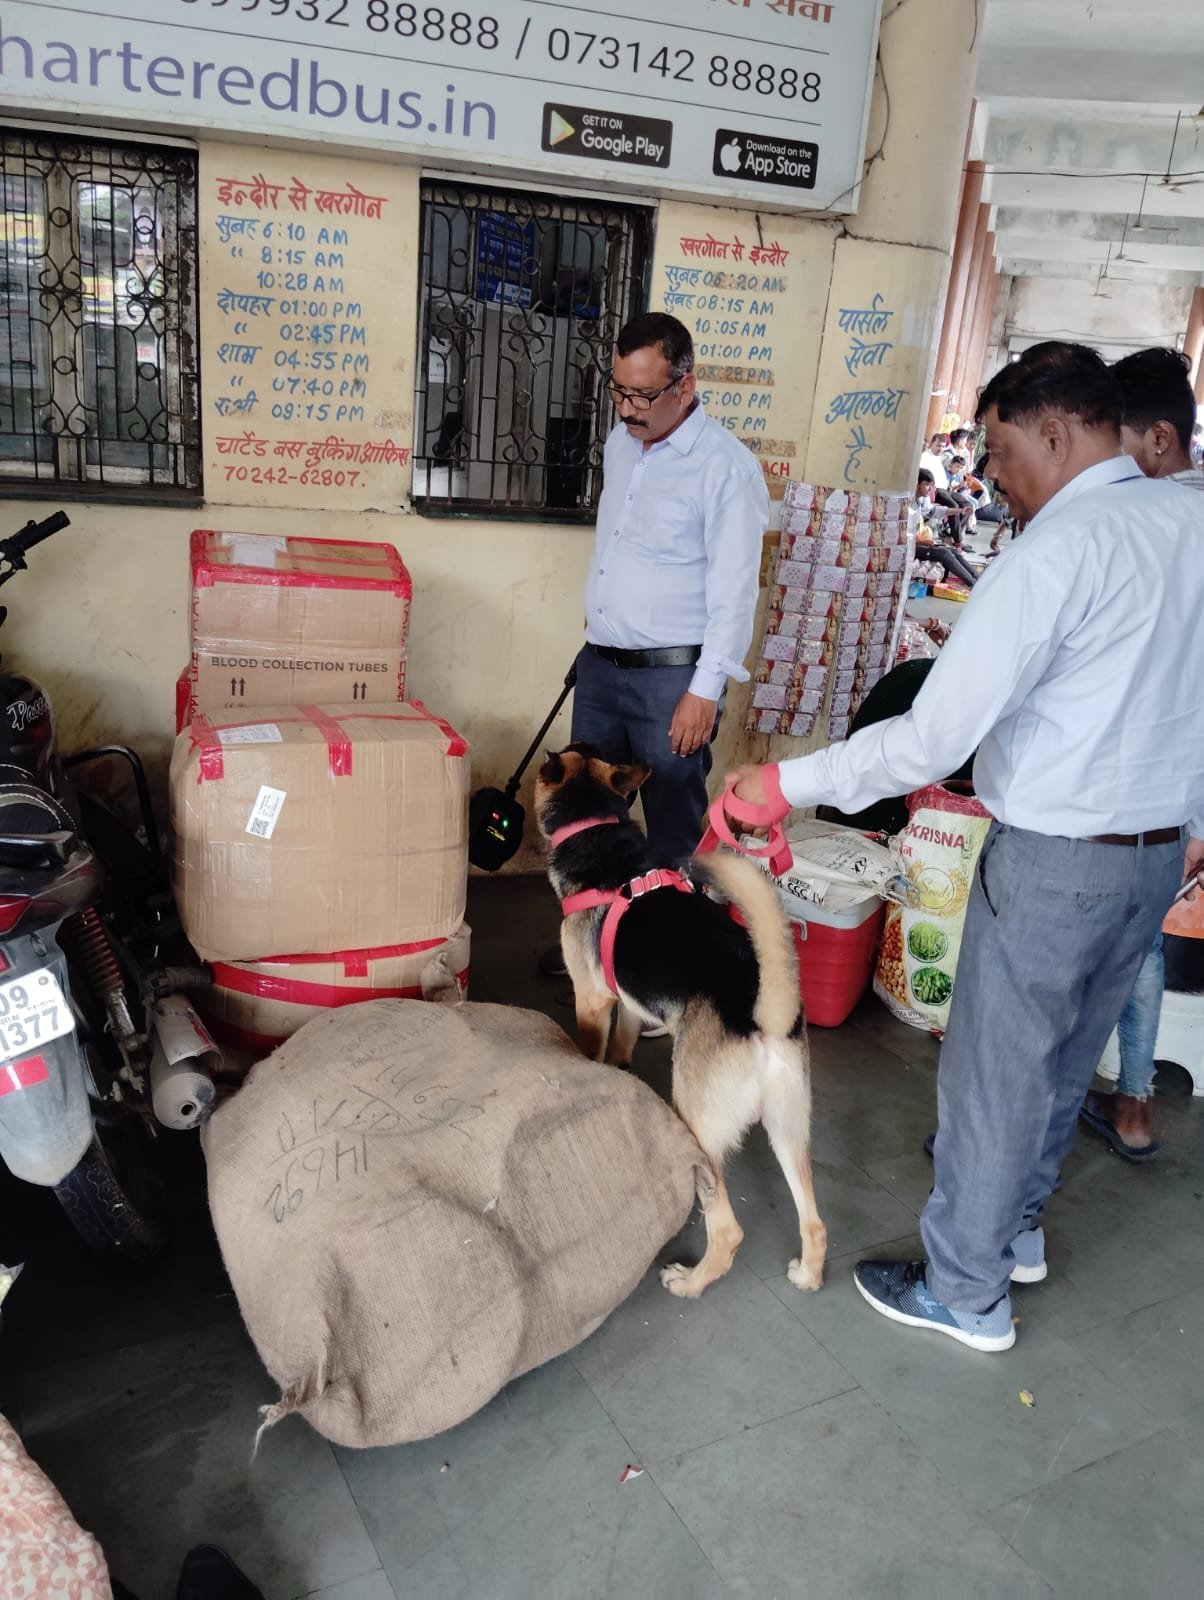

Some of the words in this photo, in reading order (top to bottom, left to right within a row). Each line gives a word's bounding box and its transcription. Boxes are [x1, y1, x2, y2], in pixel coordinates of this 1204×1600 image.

[366, 0, 500, 50] 88888
[548, 28, 695, 83] 073142
[708, 55, 822, 103] 88888
[582, 114, 598, 127] GET
[599, 117, 607, 128] IT
[608, 118, 623, 130] ON
[581, 129, 633, 157] Google
[635, 139, 664, 162] Play
[746, 139, 785, 155] Download
[787, 146, 798, 157] on
[799, 147, 812, 160] the
[745, 155, 773, 177] App
[775, 157, 811, 179] Store
[216, 173, 285, 210] इन्दौर
[288, 176, 313, 211] से
[314, 183, 389, 219] खरगोन
[263, 222, 305, 241] 6:10
[317, 228, 349, 246] AM
[262, 246, 306, 265] 8:15
[315, 252, 344, 268] AM
[680, 233, 730, 259] खरगोन
[731, 235, 745, 262] से
[749, 241, 789, 267] इन्दौर
[257, 270, 308, 291] 10:28
[313, 276, 344, 293] AM
[217, 288, 276, 317] दोपहर
[280, 300, 328, 318] 01:00
[333, 302, 362, 318] PM
[750, 300, 774, 316] AM
[280, 323, 336, 344] 02:45
[340, 325, 366, 346] PM
[695, 318, 739, 334] 10:05
[741, 322, 766, 338] AM
[217, 343, 262, 364] शाम
[274, 350, 337, 370] 04:55
[342, 353, 369, 373] PM
[700, 344, 742, 359] 01:00
[748, 346, 772, 360] PM
[845, 337, 893, 377] सेवा
[272, 377, 334, 396] 07:40
[339, 378, 367, 398] PM
[748, 393, 772, 410] PM
[336, 405, 364, 421] PM
[742, 416, 766, 431] PM
[274, 441, 308, 460] बस
[211, 656, 258, 668] BLOOD
[262, 659, 344, 671] COLLECTION
[348, 662, 388, 673] TUBES
